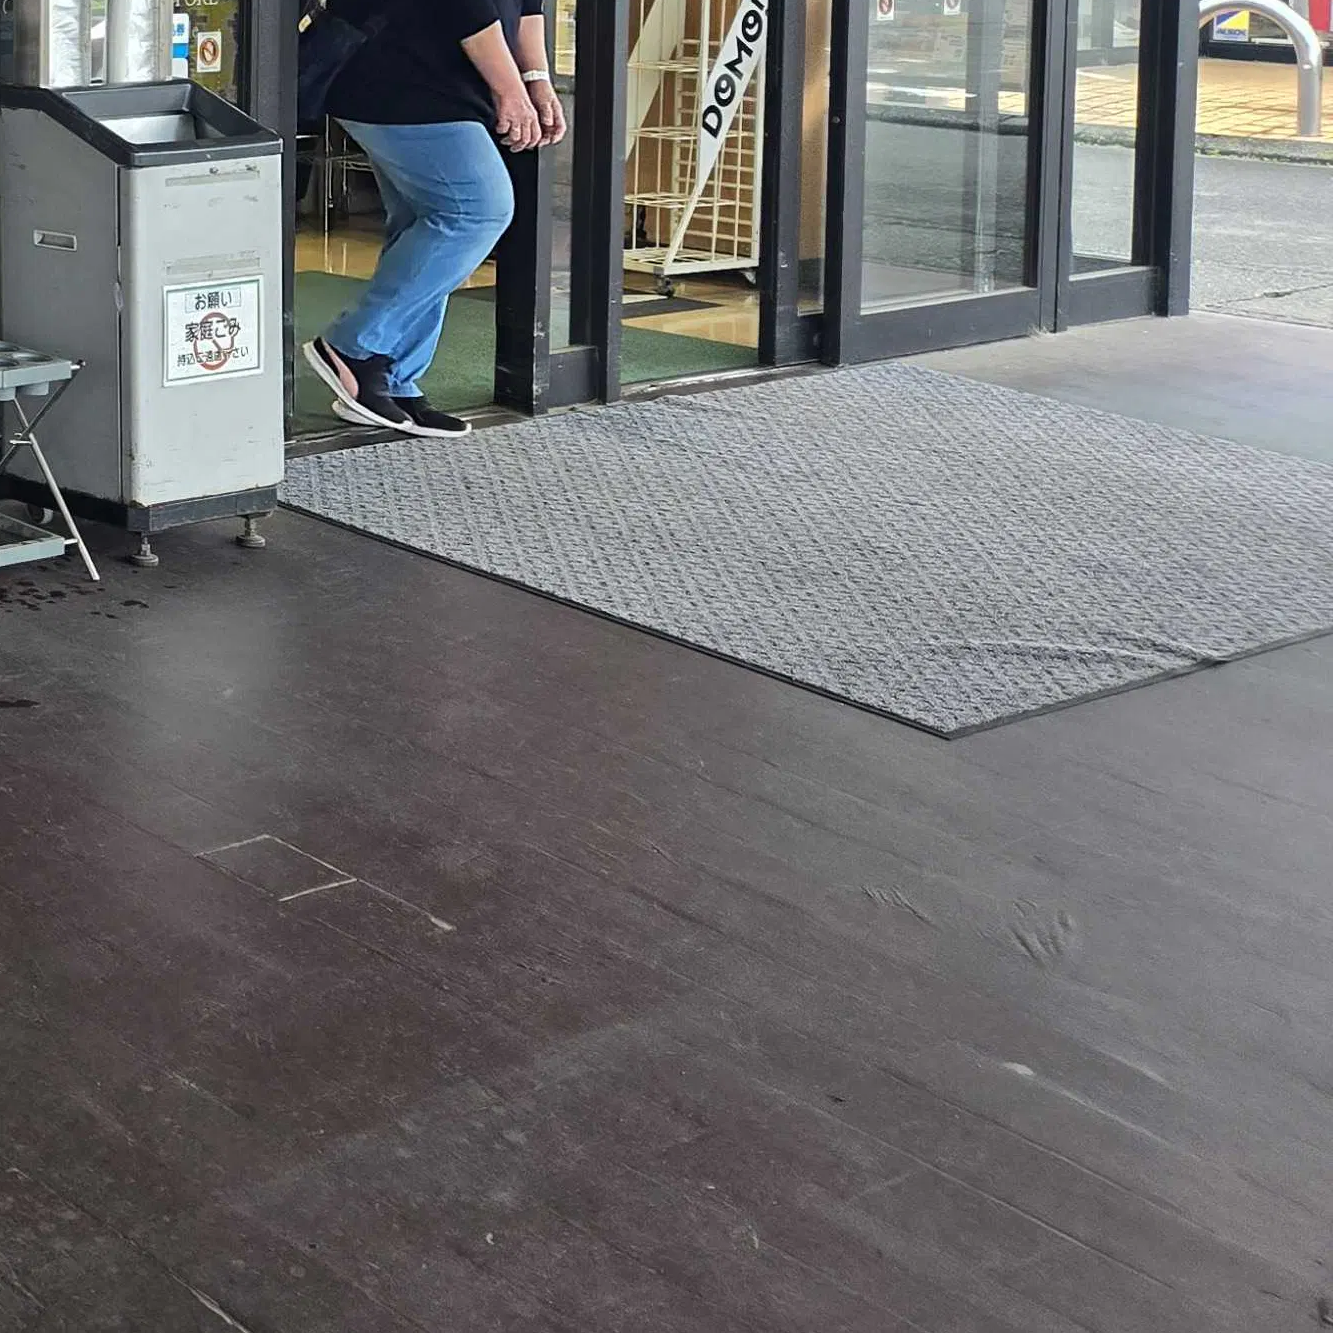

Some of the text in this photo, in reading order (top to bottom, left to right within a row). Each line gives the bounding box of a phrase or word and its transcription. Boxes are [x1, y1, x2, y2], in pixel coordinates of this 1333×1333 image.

[194, 291, 233, 311] お願い
[184, 317, 242, 343] 家庭ごみ
